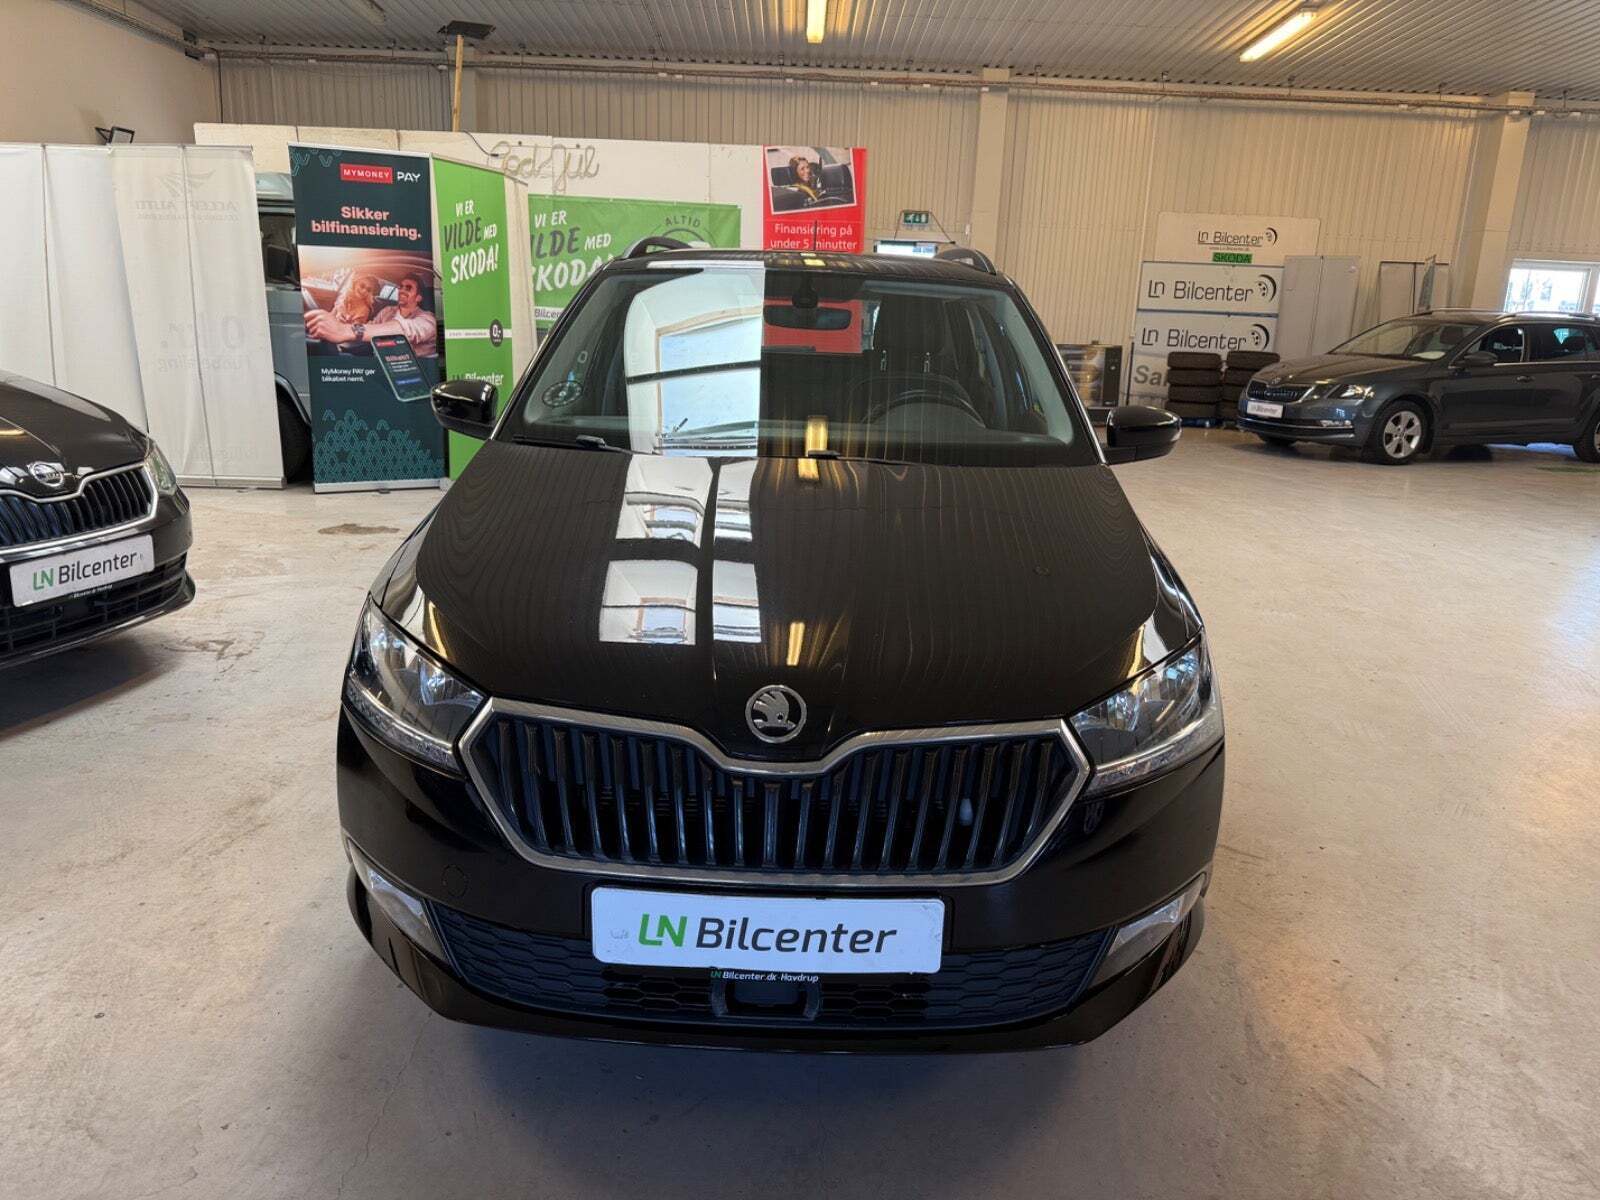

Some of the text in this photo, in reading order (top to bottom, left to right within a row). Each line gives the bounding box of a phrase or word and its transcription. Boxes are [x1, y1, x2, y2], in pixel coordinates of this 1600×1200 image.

[343, 168, 421, 182] MYMONEY PAY
[341, 206, 390, 221] Sikker
[455, 199, 475, 217] VI ER
[534, 210, 568, 228] VI ER
[665, 215, 701, 229] ALTID
[311, 220, 421, 240] bilfinansiering.
[444, 217, 498, 253] VILDE MED
[774, 223, 853, 238] Finansiering på
[1213, 231, 1264, 246] Bilcenter
[585, 233, 612, 251] MED
[770, 238, 858, 250] under 5 minutter
[450, 243, 499, 284] SKODA!
[1174, 280, 1254, 302] Bilcenter
[1167, 328, 1247, 350] Bilcenter
[32, 552, 138, 591] LN Bilcenter
[638, 913, 897, 954] LN Bilcenter
[710, 971, 819, 983] LN Bilcenter.dk Havdrup
